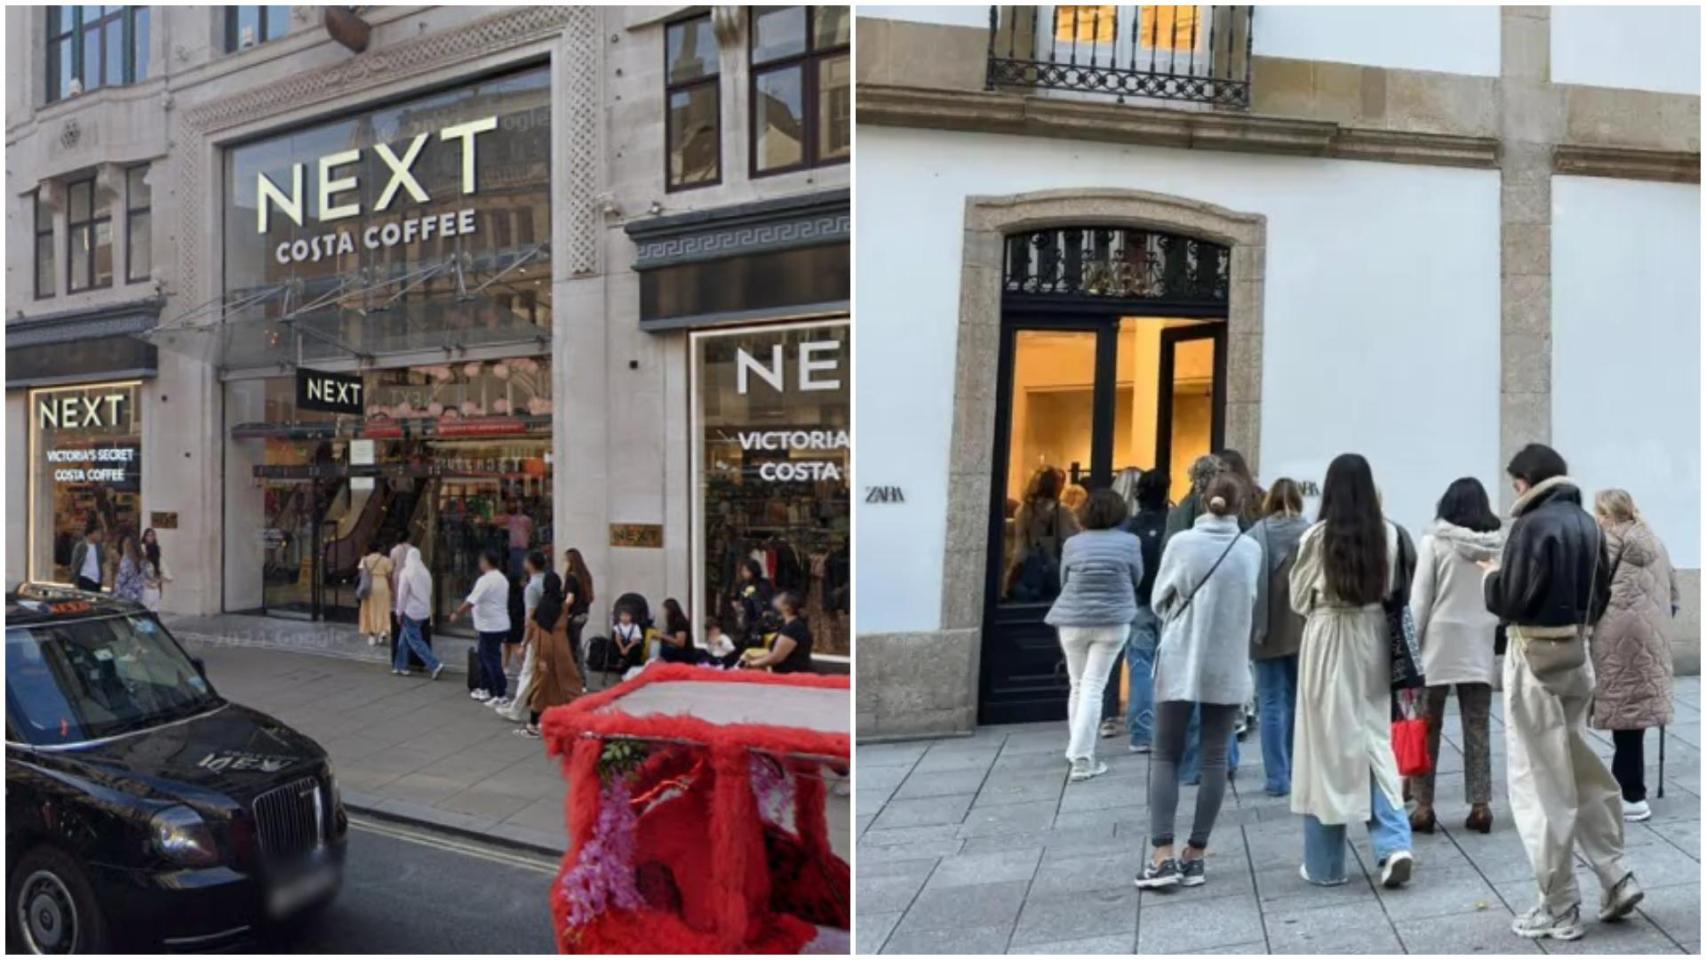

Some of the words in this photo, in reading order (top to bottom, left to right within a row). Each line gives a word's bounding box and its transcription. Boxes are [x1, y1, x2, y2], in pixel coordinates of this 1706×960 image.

[257, 116, 498, 234] NEXT
[276, 235, 354, 264] COSTA
[364, 209, 476, 250] COFFEE
[307, 379, 361, 406] NEXT
[40, 394, 124, 429] NEXT
[738, 431, 850, 450] VICTORIA
[47, 449, 97, 461] VICTORIA'S
[97, 448, 134, 461] SECRET
[55, 469, 85, 481] COSTA
[87, 468, 124, 481] COFFEE
[760, 462, 840, 481] COSTA
[865, 486, 904, 503] ZARA
